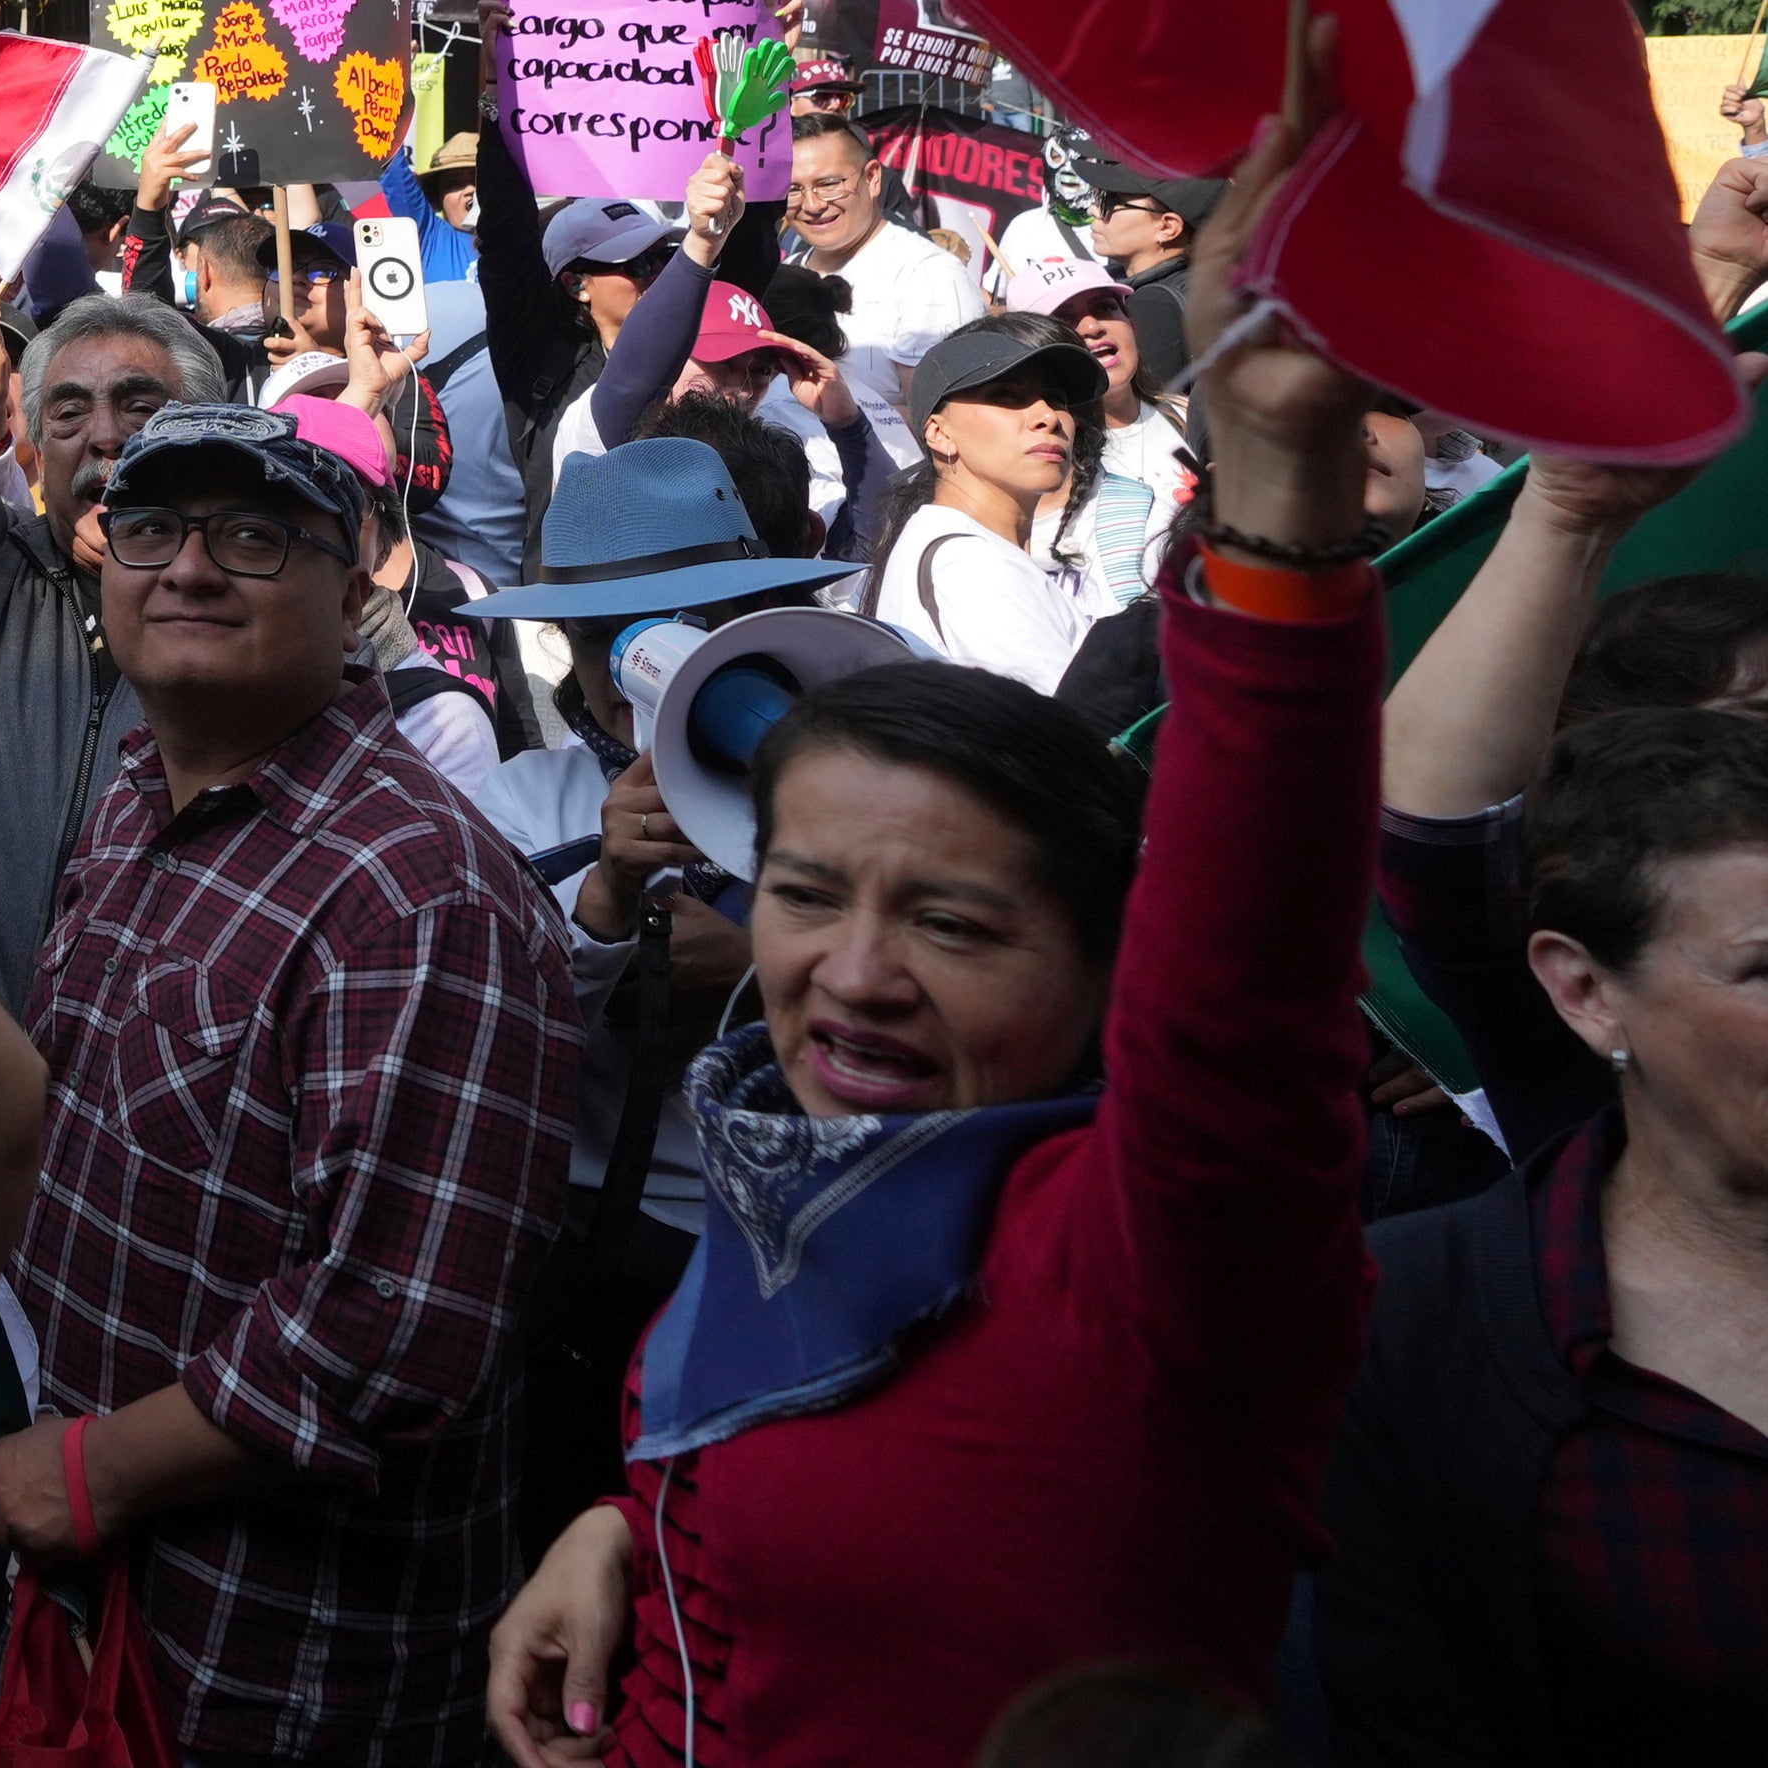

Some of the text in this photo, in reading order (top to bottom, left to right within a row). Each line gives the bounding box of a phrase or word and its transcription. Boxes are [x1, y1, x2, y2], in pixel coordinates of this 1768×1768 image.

[131, 16, 191, 39] Aguilar
[221, 10, 255, 31] Jorge
[221, 31, 262, 49] Mario
[617, 22, 697, 53] que
[882, 27, 903, 47] SE
[906, 31, 956, 59] VENDIÓ
[955, 43, 966, 58] A
[204, 55, 252, 78] Pardo
[507, 58, 695, 89] capacidad
[879, 45, 908, 66] POR
[913, 53, 952, 77] UNAS
[346, 66, 400, 101] Alberto
[363, 93, 395, 122] Pérez
[1043, 264, 1078, 286] PJF
